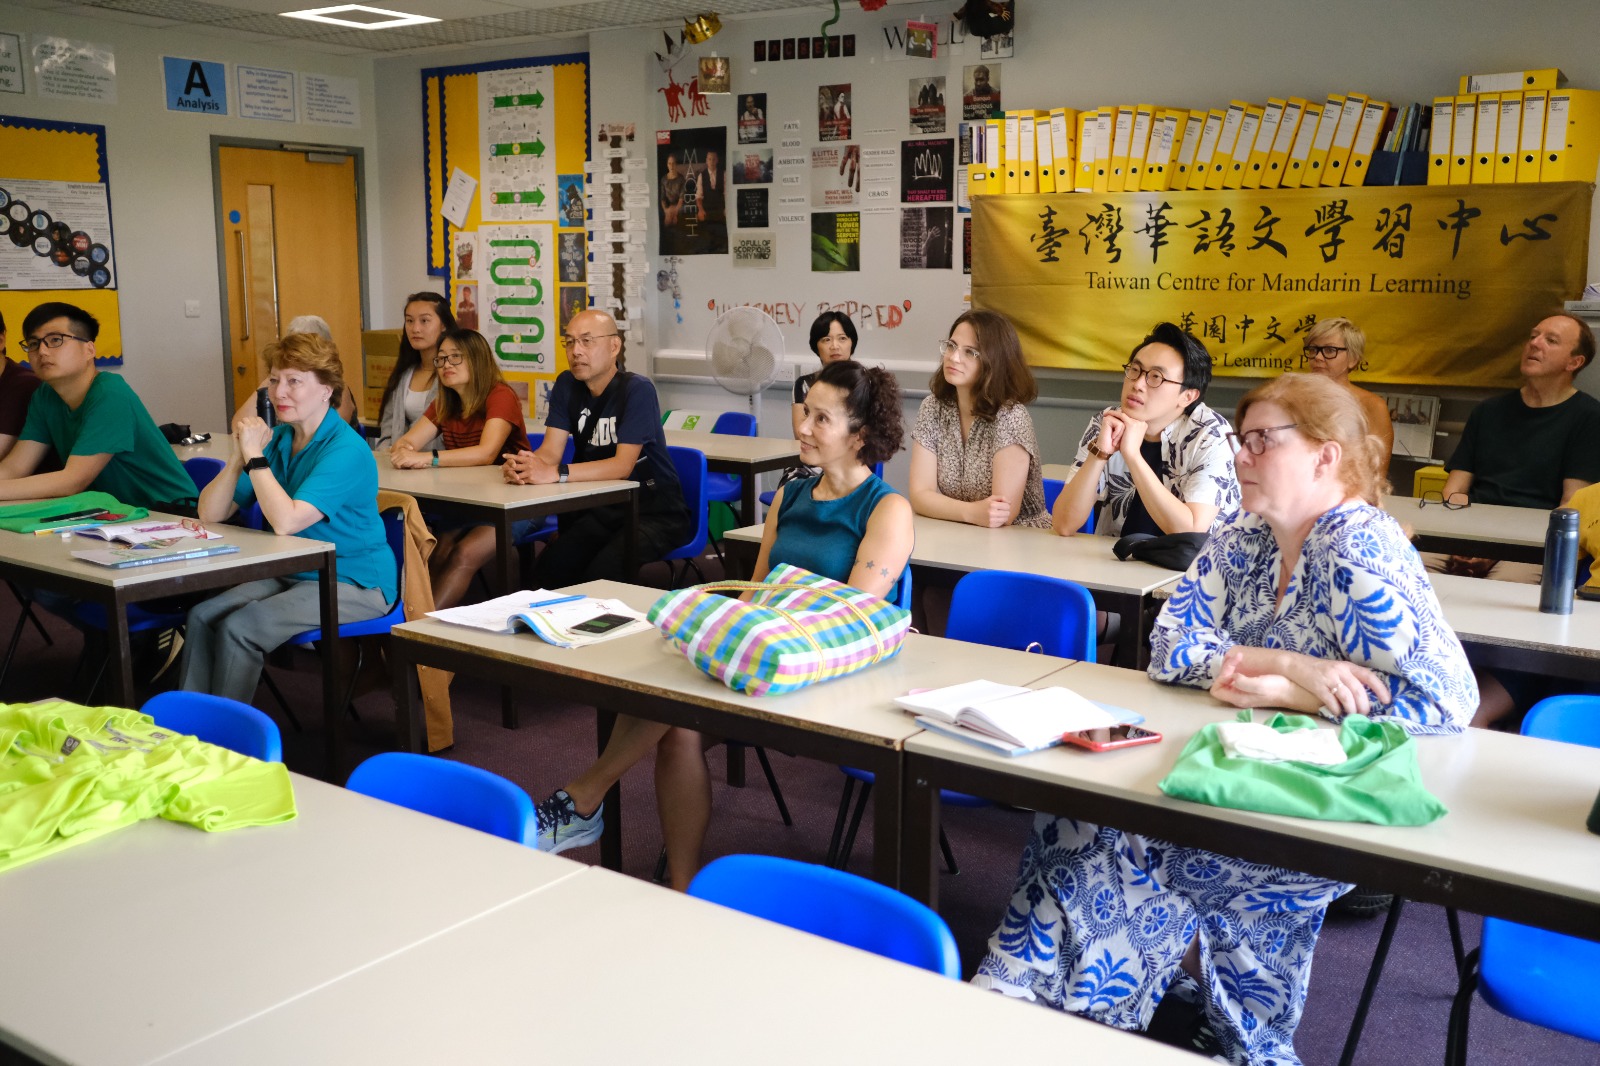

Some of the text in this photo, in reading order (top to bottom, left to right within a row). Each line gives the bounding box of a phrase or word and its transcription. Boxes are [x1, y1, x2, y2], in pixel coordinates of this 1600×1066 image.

[184, 61, 211, 97] A
[177, 96, 220, 111] Analysis
[782, 140, 801, 148] BLOOD
[778, 158, 805, 166] AMBITION
[782, 176, 799, 184] GUILT
[683, 147, 699, 237] MACBETH
[778, 214, 805, 223] VIOLENCE
[1030, 199, 1559, 264] 臺灣華語文學習中心
[1085, 271, 1472, 300] Taiwan Centre for Mandarin Learning
[1223, 352, 1293, 373] Learning
